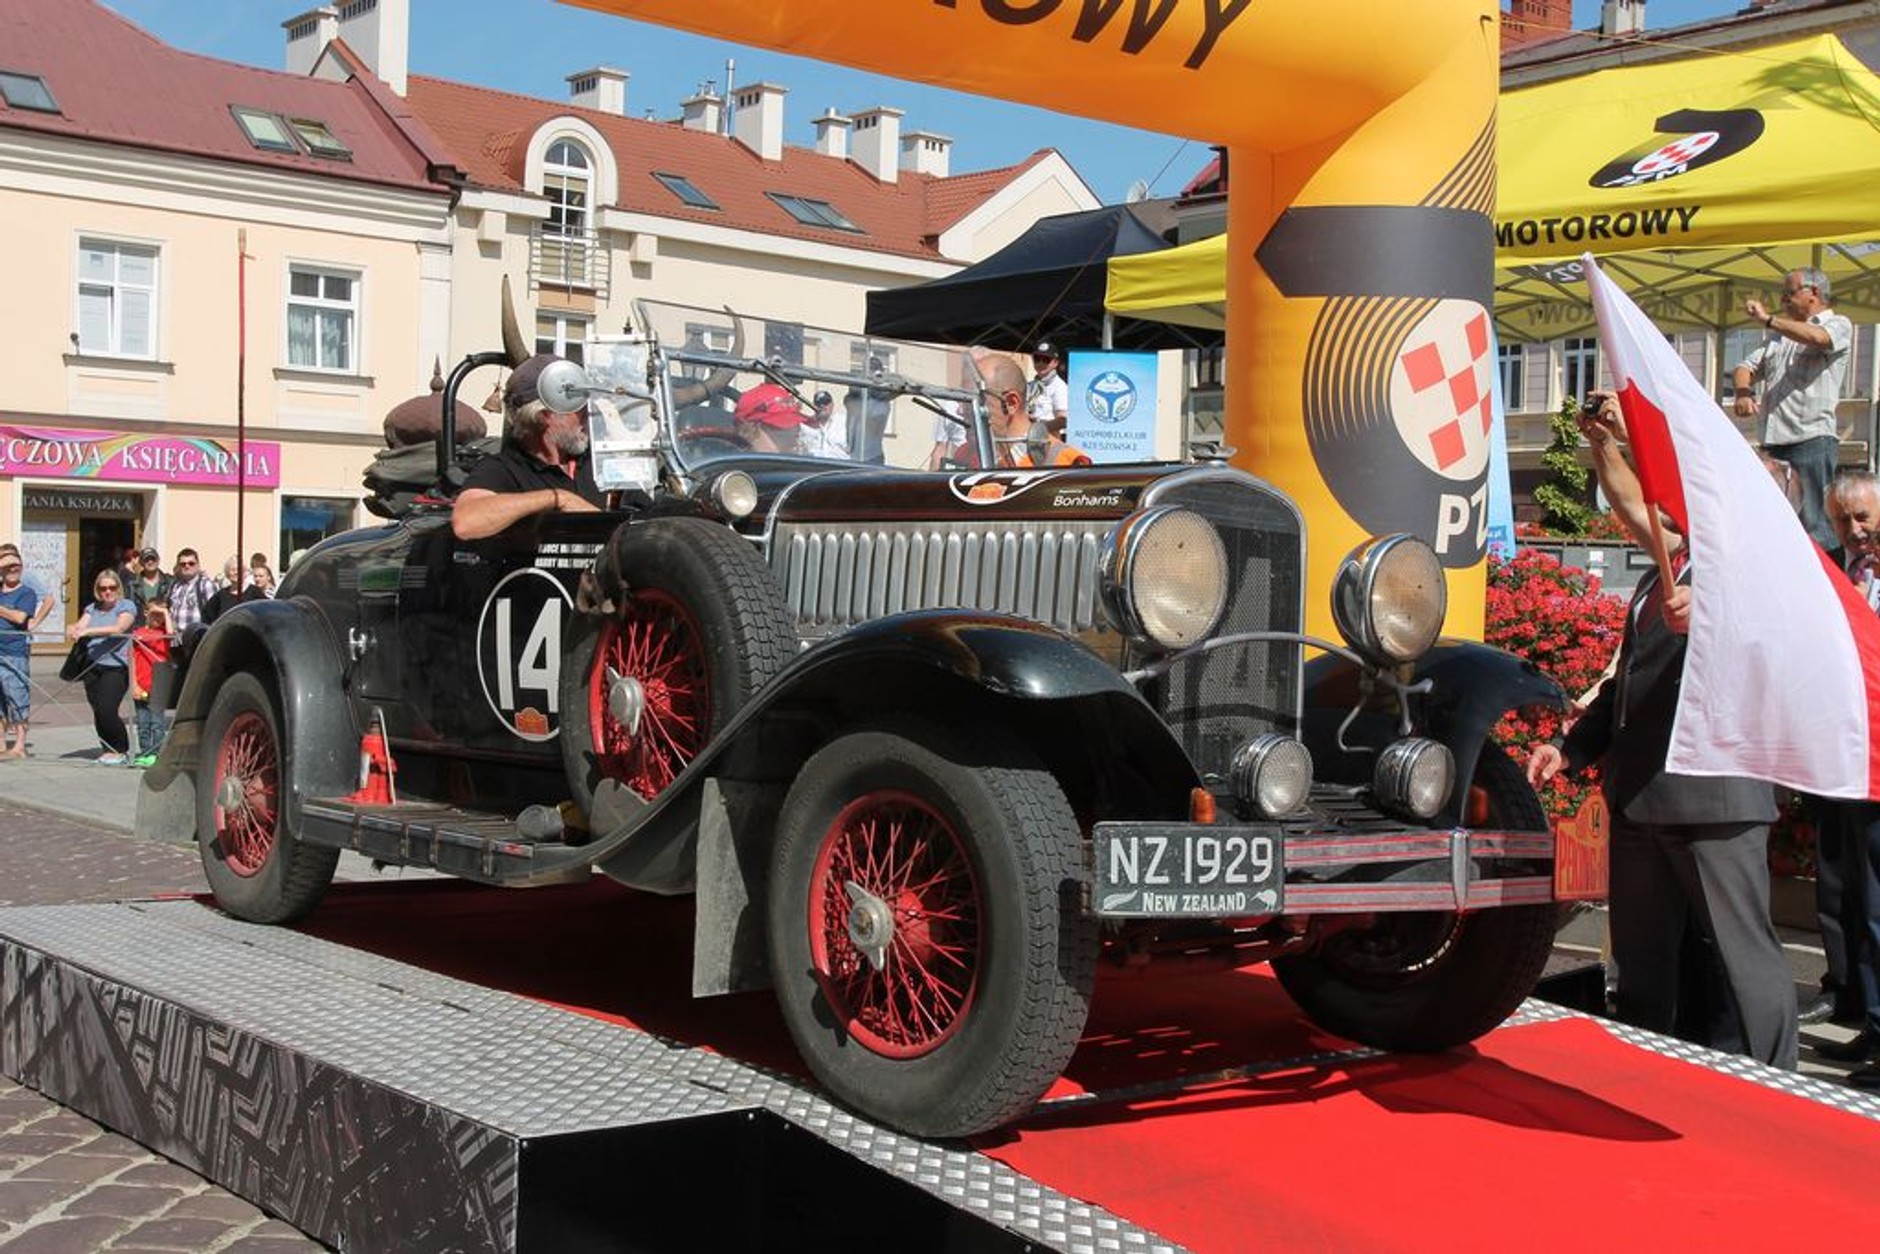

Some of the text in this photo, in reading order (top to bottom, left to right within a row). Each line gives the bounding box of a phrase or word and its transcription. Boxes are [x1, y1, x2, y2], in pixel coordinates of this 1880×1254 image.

[1495, 206, 1701, 247] MOTOROWY
[1075, 430, 1147, 440] AUTOMOBILKLUB
[121, 445, 270, 479] KSIĘGARNIA
[68, 495, 133, 513] KSIĄŻKA
[1053, 494, 1119, 507] Bonhams
[496, 598, 561, 713] 14
[1110, 836, 1273, 885] NZ 1929
